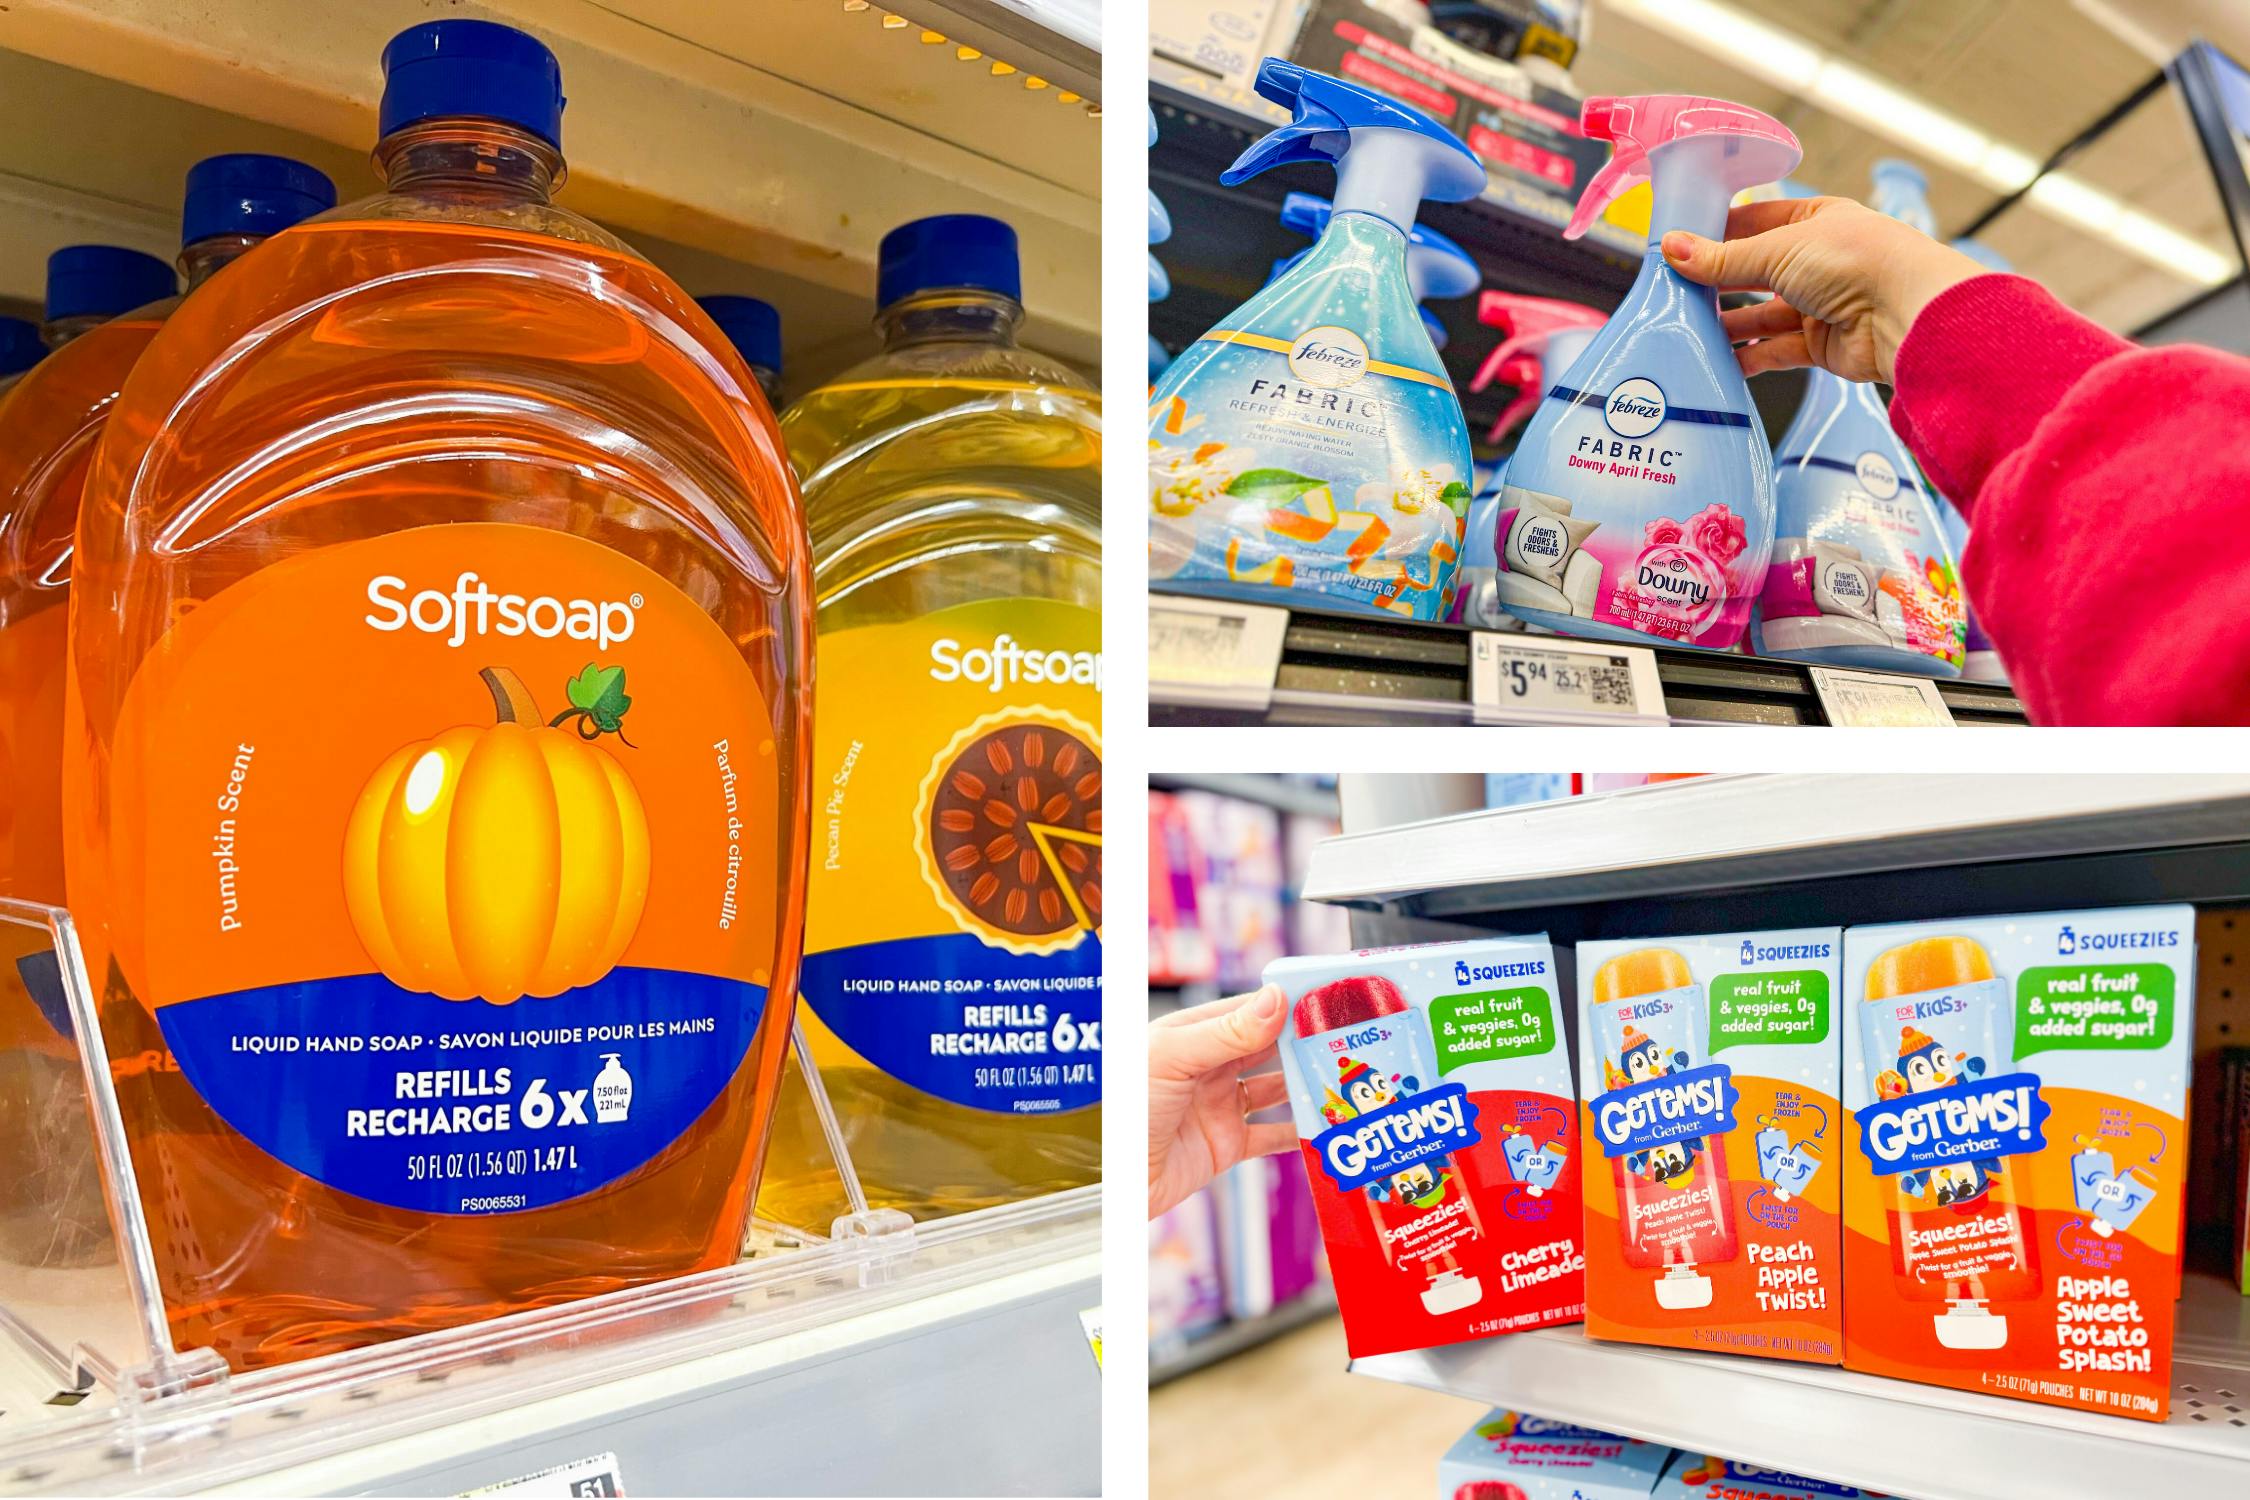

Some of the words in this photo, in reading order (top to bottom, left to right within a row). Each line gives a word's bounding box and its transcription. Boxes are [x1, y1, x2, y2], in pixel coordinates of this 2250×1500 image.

[1296, 342, 1362, 369] febreze
[1609, 393, 1661, 418] febreze
[1302, 412, 1312, 422] &
[1316, 417, 1387, 438] ENERGIZE
[1568, 455, 1606, 474] Downy
[1609, 462, 1638, 478] April
[1642, 467, 1677, 485] Fresh
[1527, 535, 1550, 547] ODORS
[1552, 539, 1558, 548] &
[1532, 526, 1557, 539] FIGHTS
[1523, 543, 1560, 557] FRESHENS
[1651, 559, 1666, 568] with
[1638, 566, 1710, 605] Downy
[1835, 571, 1858, 582] FIGHTS
[1656, 595, 1682, 607] scent
[1832, 586, 1865, 598] FRESHENS
[833, 739, 864, 787] Scent
[217, 742, 255, 812] Scent
[713, 738, 737, 813] Parfum
[826, 788, 845, 815] Pie
[728, 816, 743, 840] de
[825, 818, 840, 870] Pecan
[211, 819, 243, 932] Pumpkin
[719, 844, 742, 929] citrouille
[1742, 951, 1752, 962] 4
[1757, 944, 1830, 961] SQUEEZIES
[2060, 937, 2073, 952] 4
[2080, 931, 2179, 949] SQUEEZIES
[1458, 967, 1469, 983] 4
[1473, 961, 1545, 981] SQUEEZIES
[2048, 974, 2086, 993] real
[2091, 973, 2139, 992] fruit
[843, 979, 894, 995] LIQUID
[898, 979, 941, 993] HAND
[944, 980, 982, 993] SOAP
[993, 979, 1041, 992] SAVON
[1043, 976, 1095, 992] LIQUIDE
[1734, 981, 1762, 996] real
[1766, 980, 1801, 995] fruit
[964, 1004, 1048, 1028] REFILLS
[1454, 1000, 1484, 1017] real
[1488, 996, 1523, 1014] fruit
[1618, 1007, 1632, 1018] FOR
[1662, 1002, 1673, 1013] 3+
[1720, 1001, 1731, 1014] &
[1736, 998, 1792, 1016] veggies,
[1797, 997, 1816, 1013] 0g
[1896, 1005, 1914, 1017] FOR
[1954, 1000, 1968, 1013] 3+
[2028, 997, 2045, 1015] &
[2050, 996, 2126, 1018] veggies,
[2131, 995, 2158, 1016] 0g
[231, 1035, 300, 1054] LIQUID
[305, 1036, 364, 1052] HAND
[368, 1035, 423, 1051] SOAP
[439, 1032, 504, 1049] SAVON
[510, 1028, 582, 1047] LIQUIDE
[587, 1025, 634, 1042] POUR
[639, 1022, 665, 1038] LES
[669, 1017, 715, 1035] MAINS
[1052, 1013, 1102, 1052] 6x
[1443, 1022, 1456, 1036] &
[1462, 1016, 1518, 1036] veggies,
[1521, 1012, 1541, 1029] 0g
[1721, 1018, 1763, 1033] added
[1767, 1016, 1815, 1034] sugar!
[2029, 1019, 2087, 1037] added
[2091, 1017, 2155, 1039] sugar!
[930, 1031, 1048, 1056] RECHARGE
[1329, 1038, 1345, 1051] FOR
[1380, 1030, 1392, 1041] 3+
[1448, 1036, 1492, 1054] added
[1496, 1029, 1542, 1051] sugar!
[395, 1067, 512, 1099] REFILLS
[974, 1068, 988, 1088] 50
[990, 1067, 1001, 1087] FL
[1003, 1067, 1015, 1087] OZ
[1018, 1066, 1042, 1088] (1.56
[1044, 1066, 1059, 1085] QT)
[1062, 1065, 1085, 1084] 1.47
[1087, 1064, 1095, 1082] L
[519, 1078, 589, 1129] 6x
[599, 1100, 613, 1111] 221
[614, 1099, 626, 1110] mL
[1776, 1092, 1792, 1100] TEAR
[1776, 1100, 1799, 1109] ENJOY
[347, 1104, 510, 1137] RECHARGE
[1774, 1109, 1800, 1117] FROZEN
[1634, 1135, 1652, 1144] from
[408, 1155, 425, 1180] 50
[429, 1154, 443, 1179] FL
[446, 1153, 463, 1178] OZ
[468, 1151, 503, 1178] (1.56
[506, 1150, 527, 1175] QT)
[533, 1146, 566, 1172] 1.47
[569, 1145, 578, 1169] L
[1371, 1161, 1392, 1173] from
[1529, 1157, 1542, 1166] OR
[1780, 1157, 1795, 1168] OR
[1912, 1151, 1934, 1161] from
[2102, 1184, 2119, 1197] OR
[461, 1195, 526, 1212] PS0065531
[1633, 1185, 1715, 1220] Squeezies!
[1384, 1196, 1469, 1244] Squeezies!
[1644, 1219, 1664, 1230] Peach
[1665, 1213, 1683, 1224] Apple
[1685, 1206, 1706, 1218] Twist!
[1908, 1212, 2014, 1248] Squeezies!
[1501, 1239, 1574, 1271] Cherry
[1747, 1240, 1814, 1264] Peach
[1909, 1250, 1930, 1261] Apple
[1932, 1246, 1958, 1257] Sweet
[1959, 1241, 1987, 1252] Potato
[1989, 1234, 2018, 1247] Splash!
[1920, 1263, 1938, 1271] Twist
[1941, 1262, 1951, 1270] for
[1959, 1257, 1975, 1267] fruit
[1984, 1251, 2011, 1262] veggie
[1943, 1264, 1990, 1279] smoothie!
[1758, 1265, 1819, 1289] Apple
[2057, 1276, 2130, 1300] Apple
[1755, 1287, 1827, 1311] Twist!
[2057, 1300, 2143, 1323] Sweet
[2056, 1324, 2148, 1347] Potato
[2058, 1348, 2151, 1372] Splash!
[1982, 1372, 1987, 1384] 4
[1996, 1375, 2007, 1388] 2.5
[2008, 1377, 2018, 1389] OZ
[2019, 1378, 2038, 1394] (71g)
[2039, 1382, 2074, 1398] POUCHES
[2079, 1387, 2092, 1402] NET
[2094, 1389, 2107, 1403] WT
[2110, 1391, 2119, 1405] 10
[2120, 1393, 2132, 1407] OZ
[1494, 1440, 1622, 1458] Squeezies!
